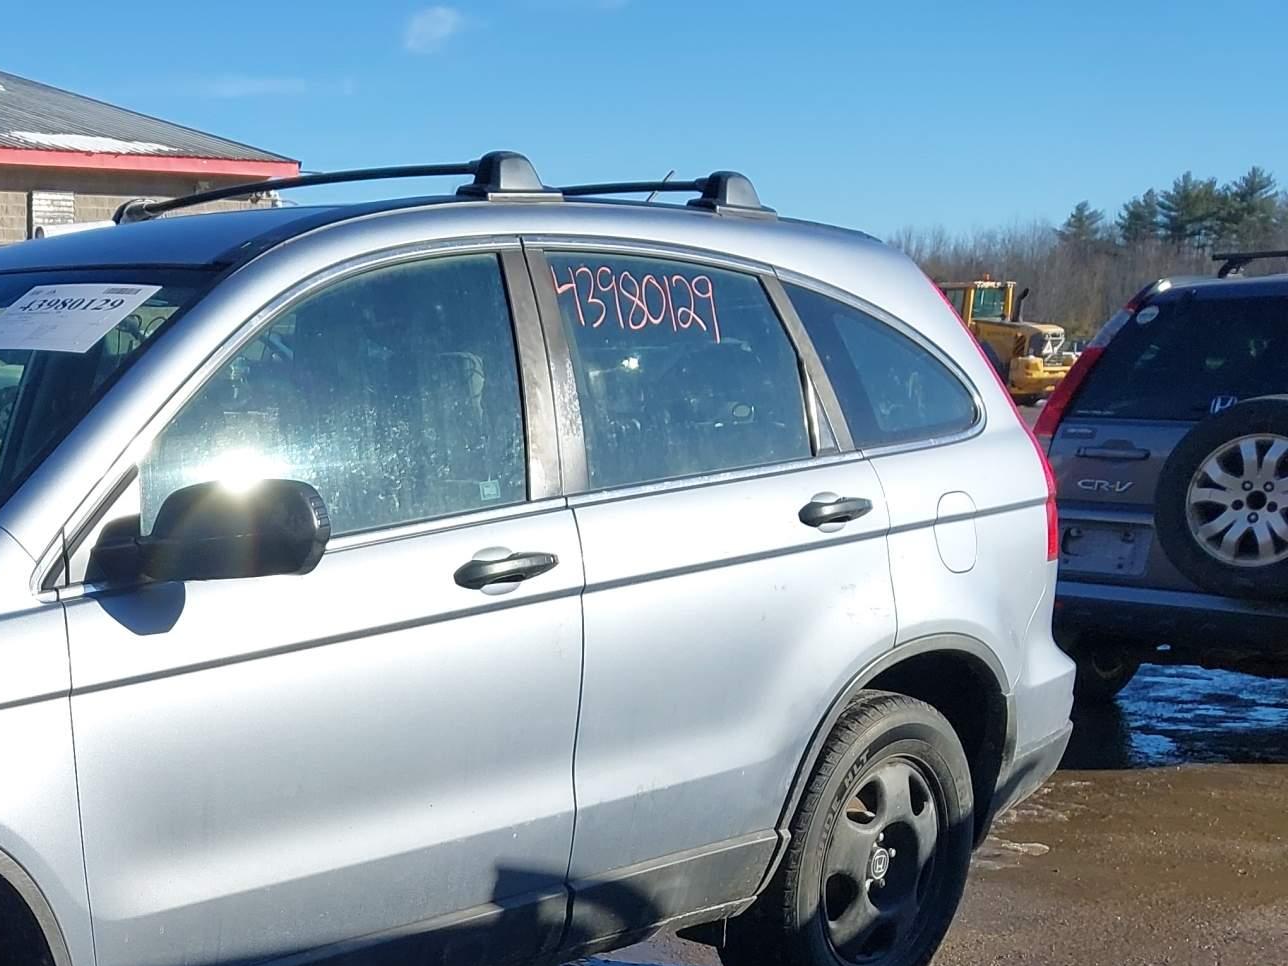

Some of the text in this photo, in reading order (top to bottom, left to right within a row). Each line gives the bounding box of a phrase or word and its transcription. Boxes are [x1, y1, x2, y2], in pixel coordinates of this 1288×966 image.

[20, 298, 125, 312] 43980129
[550, 265, 721, 344] 43980129
[1077, 479, 1134, 492] CR-V
